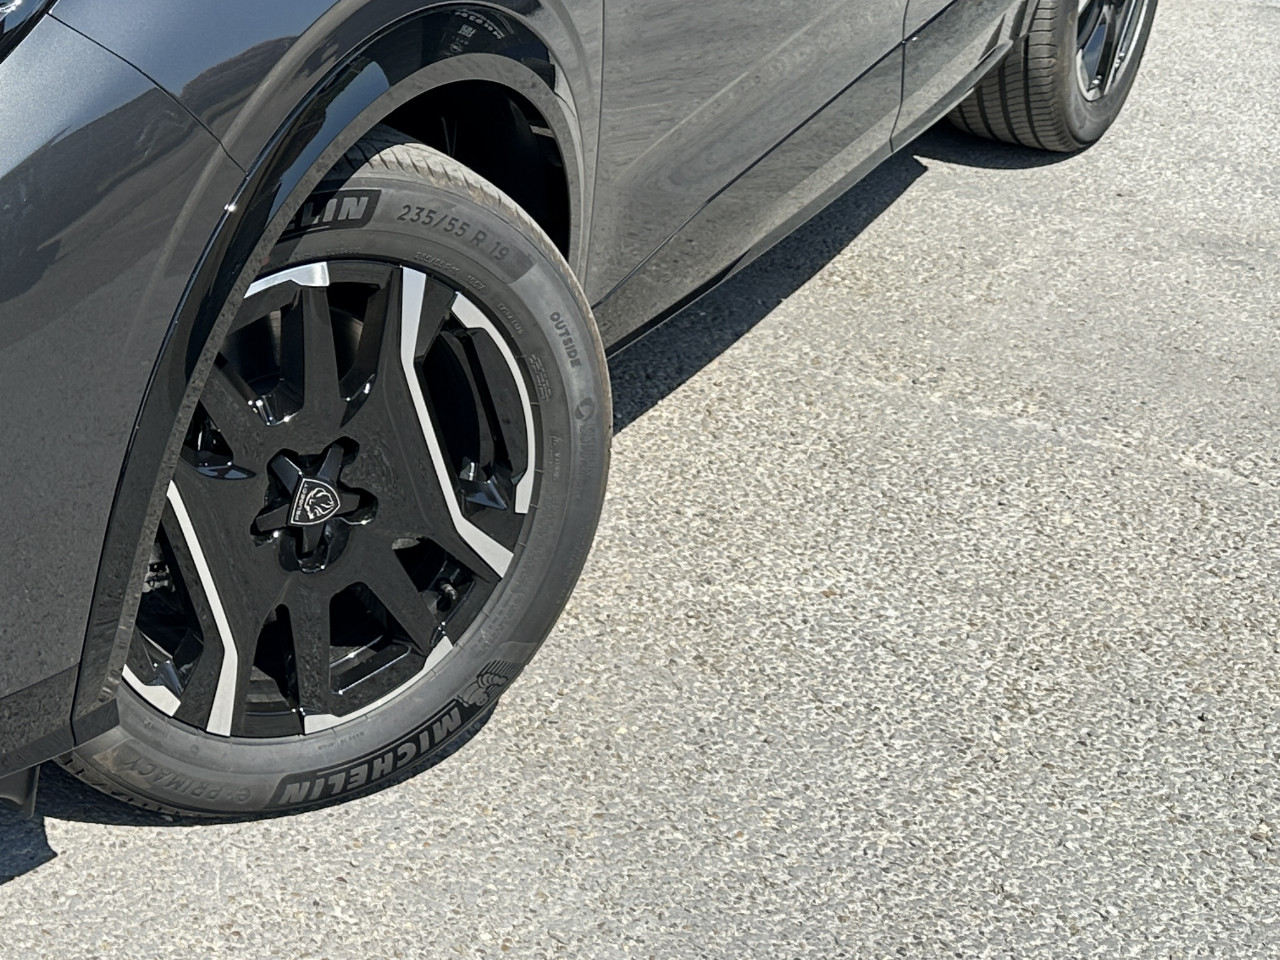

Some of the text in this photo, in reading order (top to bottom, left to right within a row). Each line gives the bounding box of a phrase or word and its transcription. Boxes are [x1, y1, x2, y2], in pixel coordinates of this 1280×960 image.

[396, 204, 511, 261] 235/55 R 19
[549, 311, 581, 368] OUTSIDE
[277, 707, 462, 804] MICHELIN
